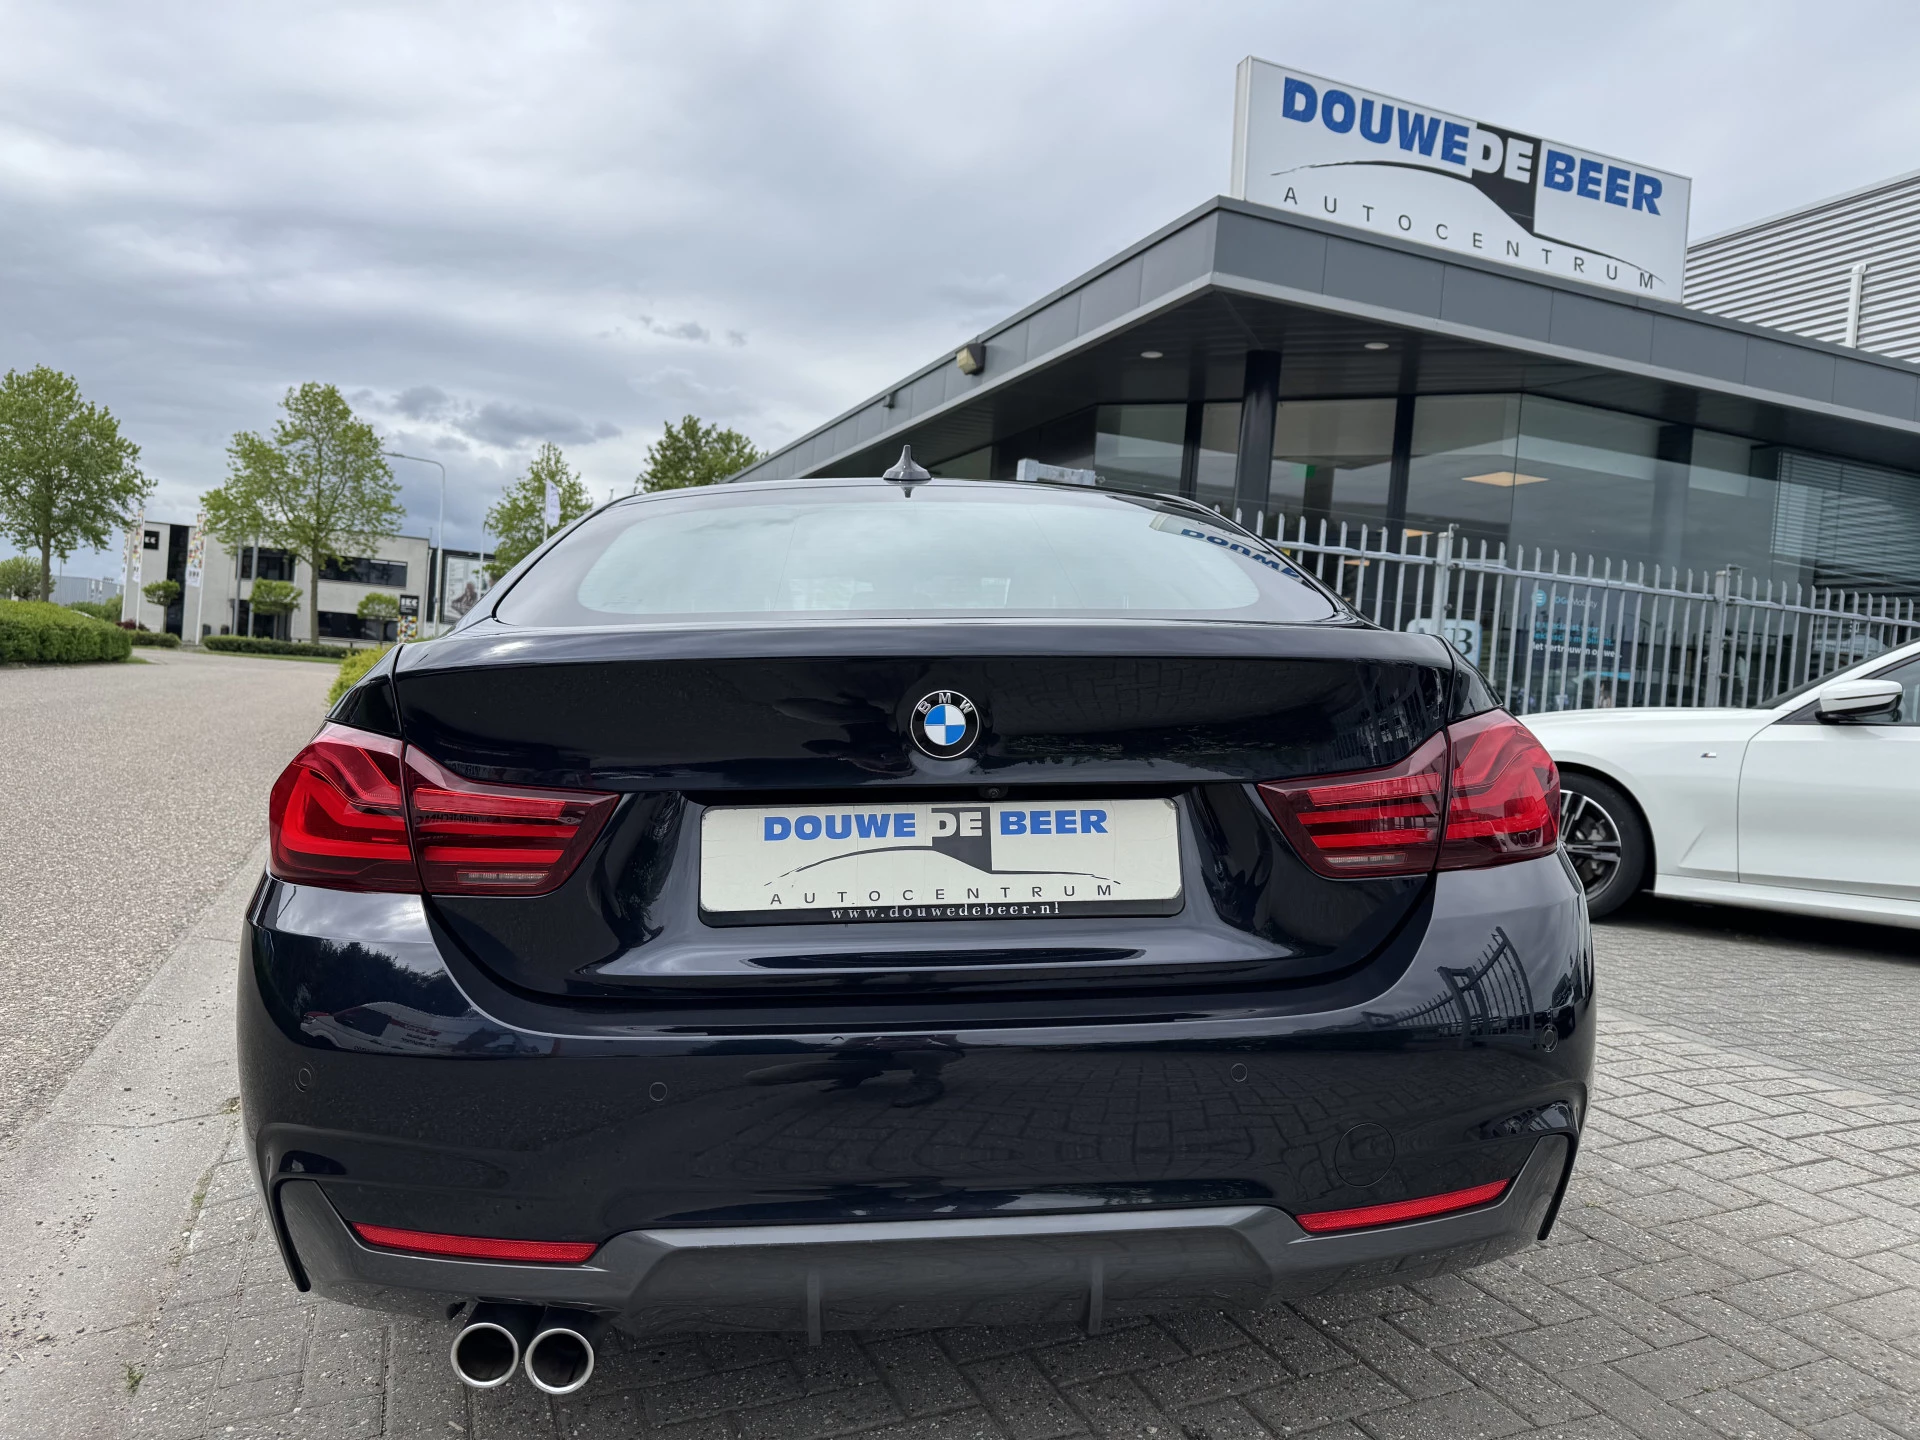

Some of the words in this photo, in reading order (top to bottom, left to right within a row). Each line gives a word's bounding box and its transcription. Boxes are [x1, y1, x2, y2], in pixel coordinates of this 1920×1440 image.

[1282, 77, 1470, 166] DOUWE
[1472, 124, 1535, 184] DE
[1543, 149, 1664, 217] BEER
[1283, 187, 1654, 290] AUTOCENTRUM
[917, 692, 973, 715] BMW
[763, 812, 916, 842] DOUWE
[932, 810, 984, 838] DE
[1000, 809, 1108, 836] BEER
[770, 884, 1112, 906] AUTOCENTRUM
[831, 901, 1061, 919] www.douwedebeer.nl
